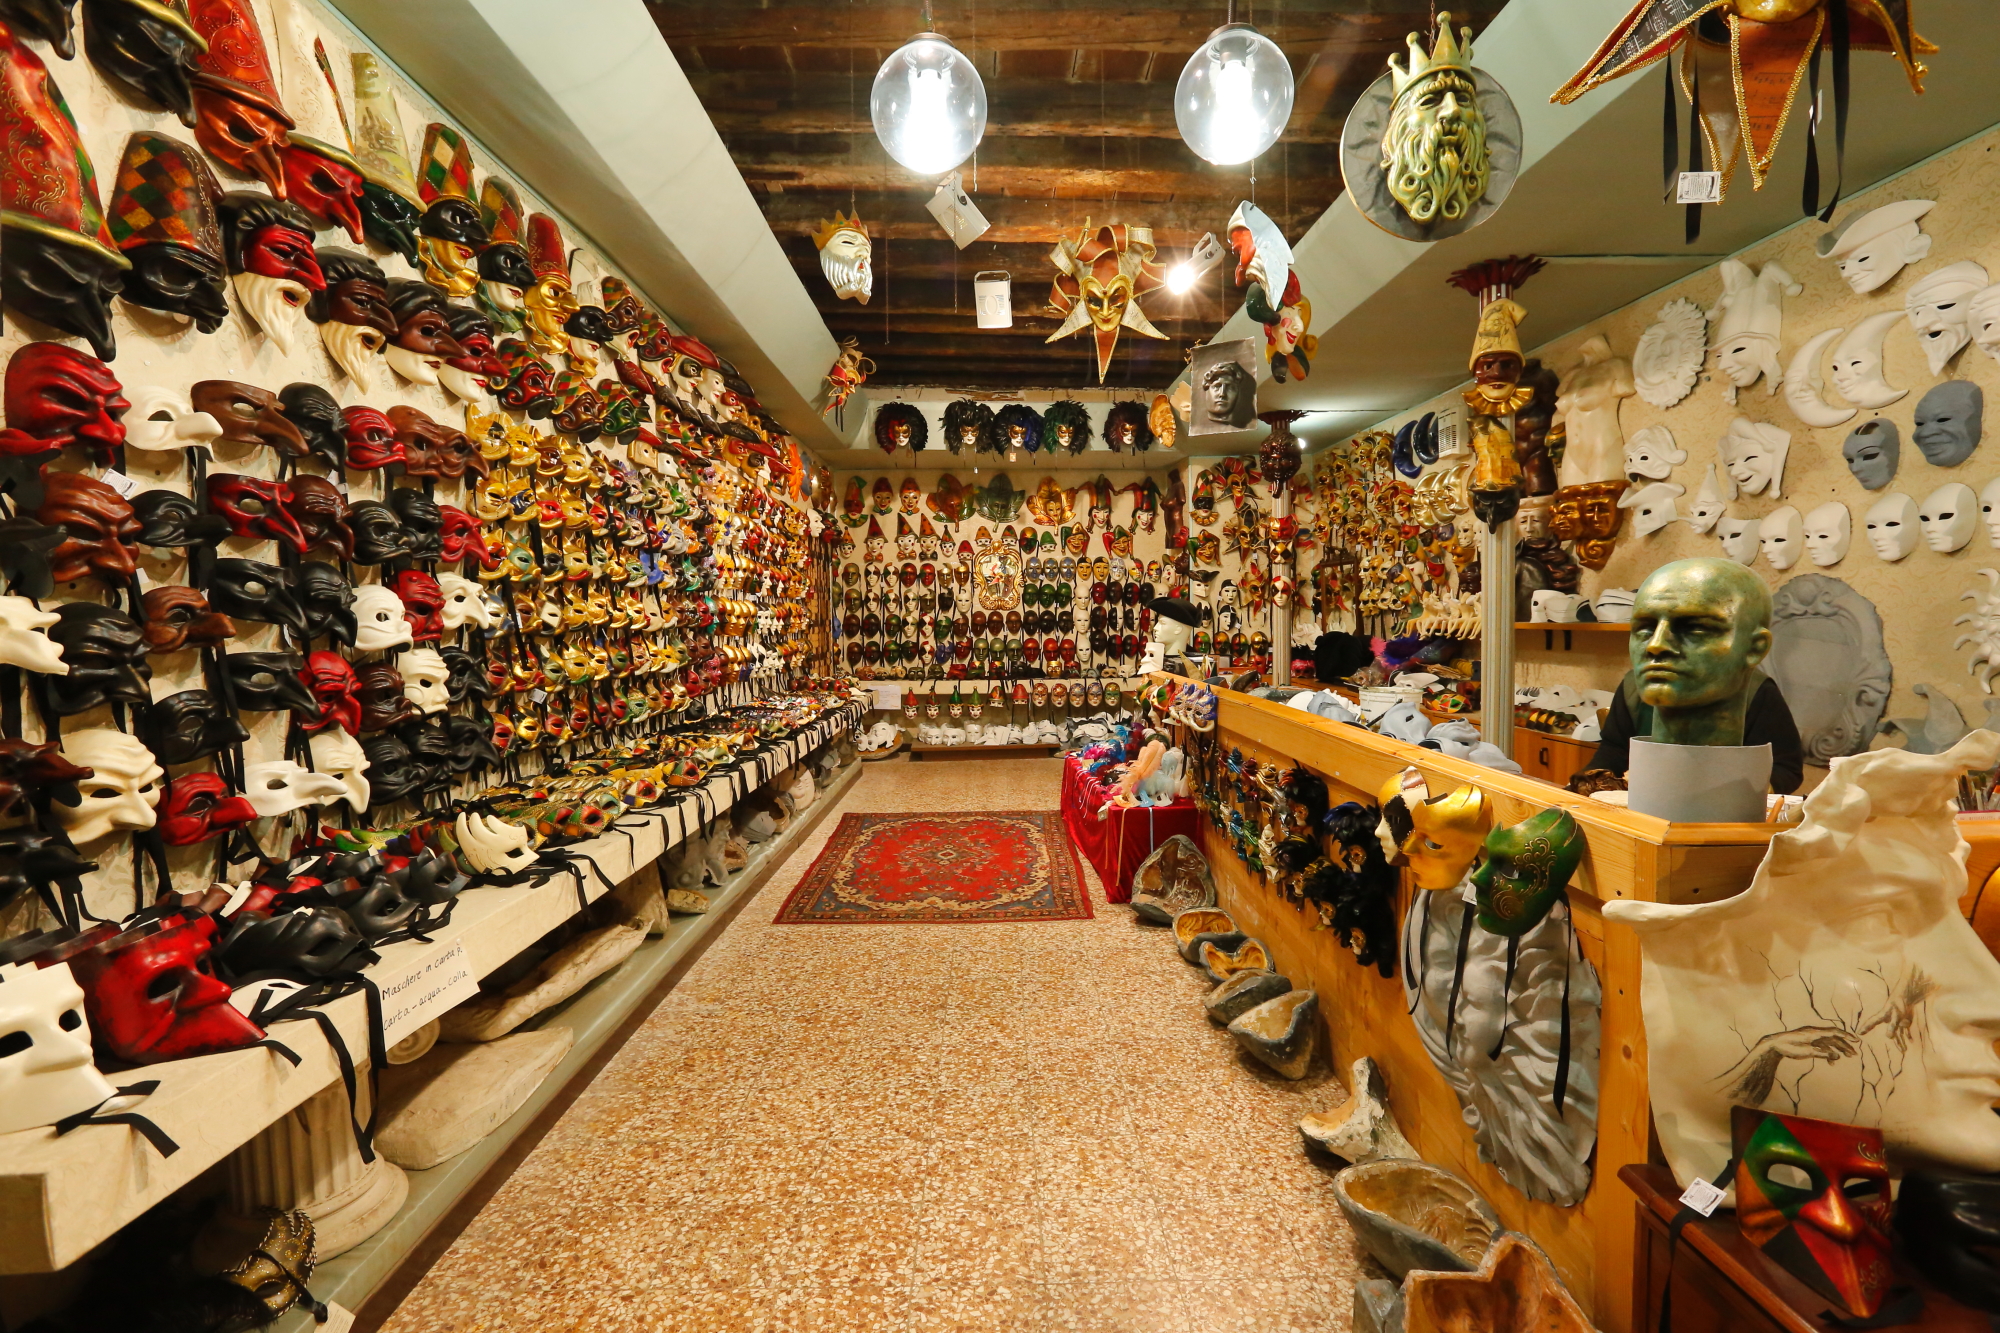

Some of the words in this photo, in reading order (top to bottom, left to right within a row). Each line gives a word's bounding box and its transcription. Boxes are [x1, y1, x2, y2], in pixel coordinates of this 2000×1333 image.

[382, 970, 421, 1001] Maschere
[425, 964, 432, 973] in
[419, 986, 441, 1006] acqua
